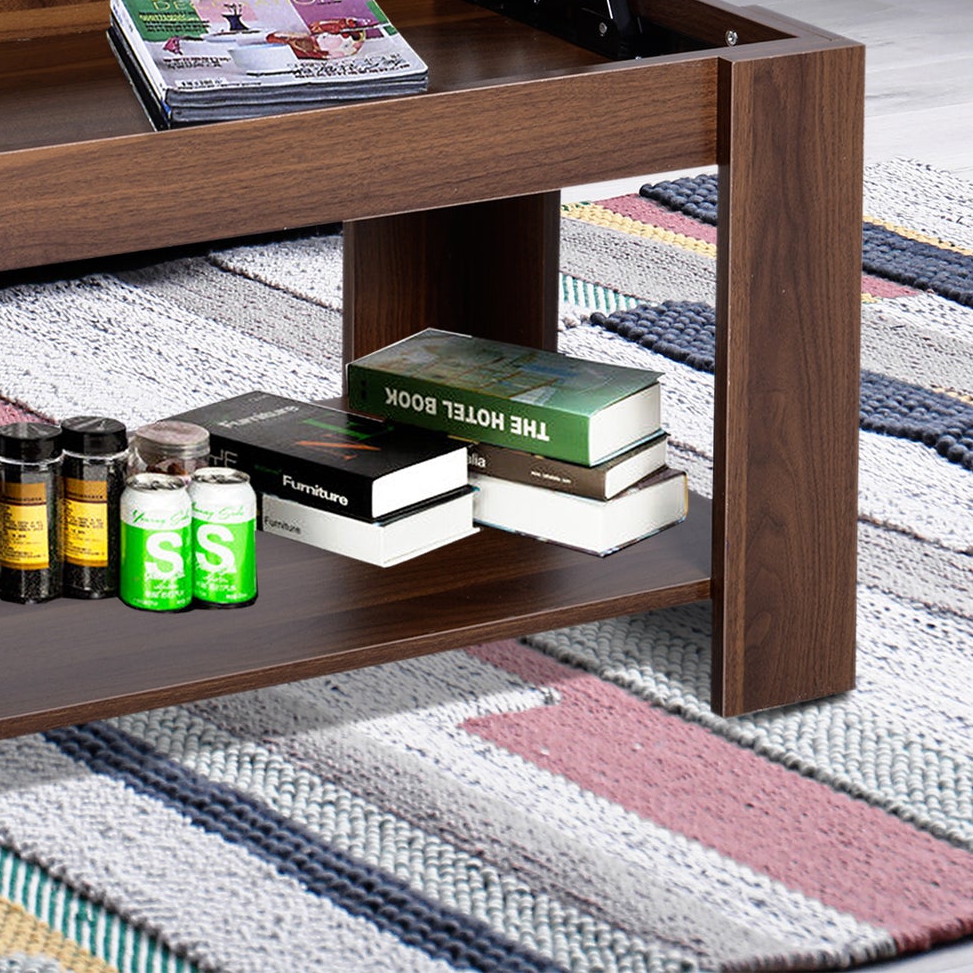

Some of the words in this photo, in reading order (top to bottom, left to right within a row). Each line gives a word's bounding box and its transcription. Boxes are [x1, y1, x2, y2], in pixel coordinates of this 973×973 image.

[384, 387, 438, 416] BOOK
[442, 400, 505, 431] HOTEL
[510, 416, 550, 442] THE
[282, 474, 349, 506] Furniture
[144, 531, 185, 580] S
[195, 524, 237, 573] S
